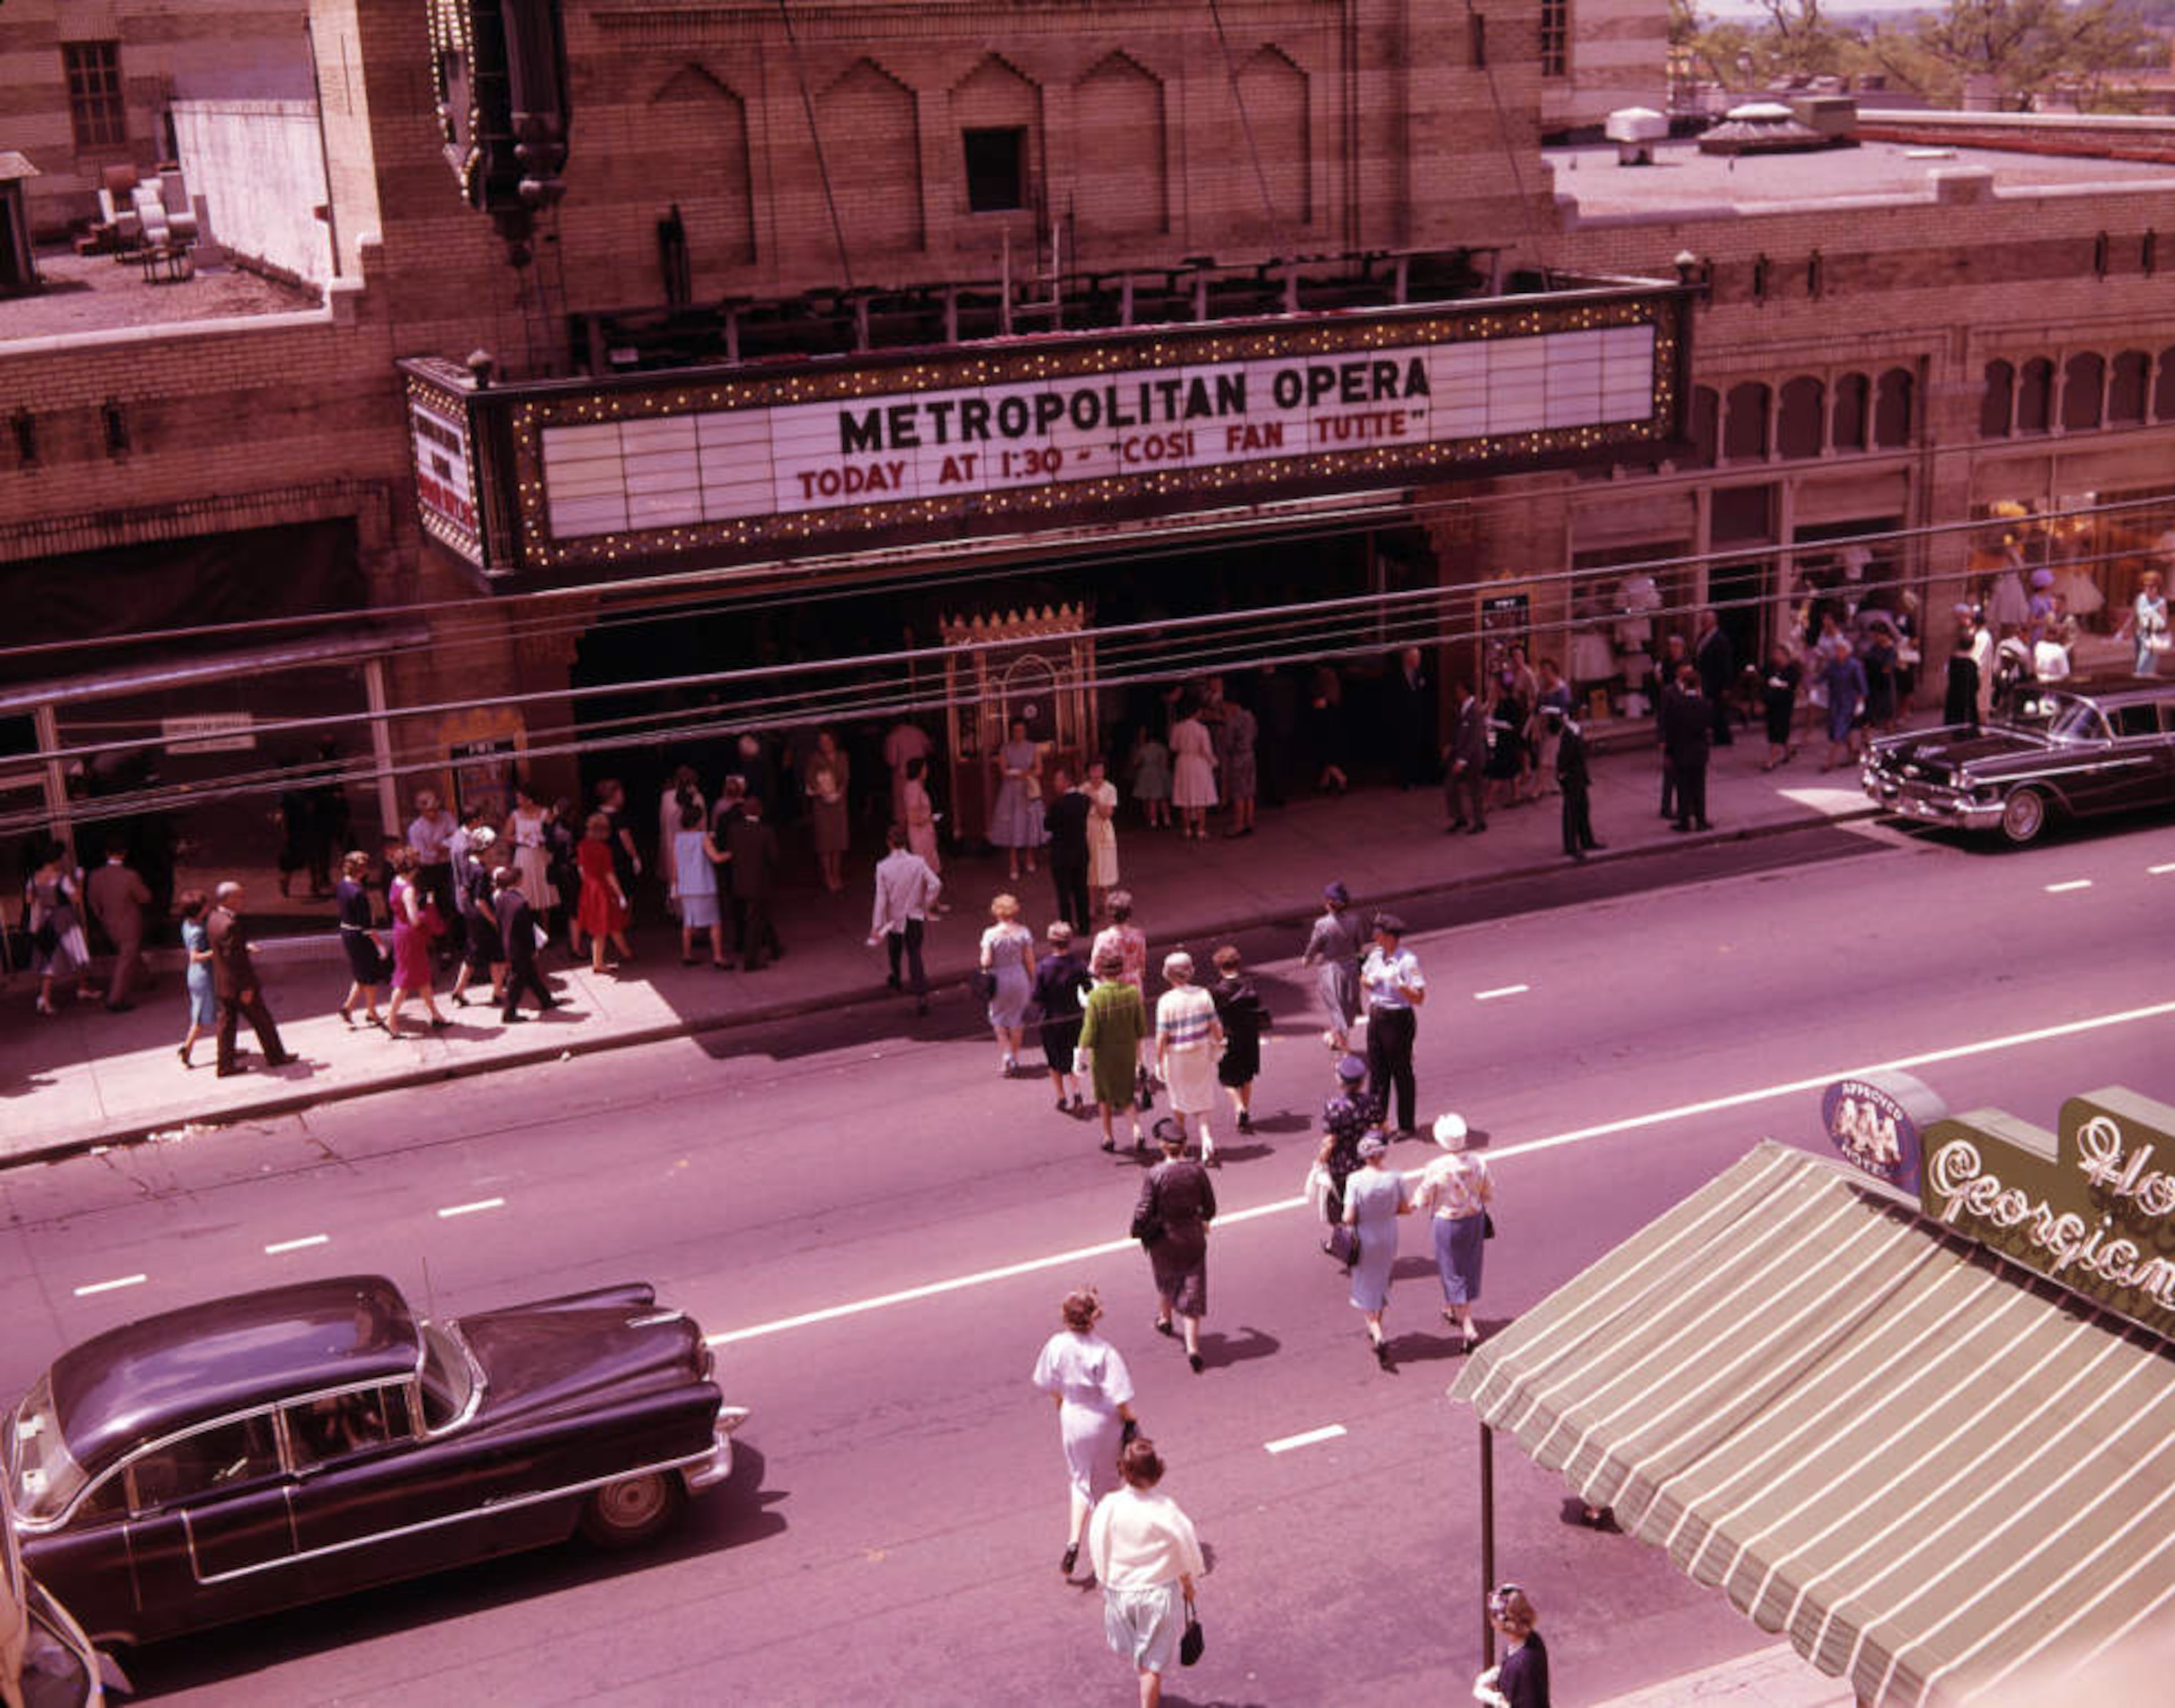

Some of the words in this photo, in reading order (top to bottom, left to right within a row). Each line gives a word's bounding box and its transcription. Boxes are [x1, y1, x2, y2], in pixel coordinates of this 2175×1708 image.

[839, 372, 1246, 455] METROPOLITAN
[1273, 357, 1431, 409] OPERA
[797, 460, 905, 500] TODAY
[939, 454, 978, 484] AT
[1227, 422, 1283, 451] FAN
